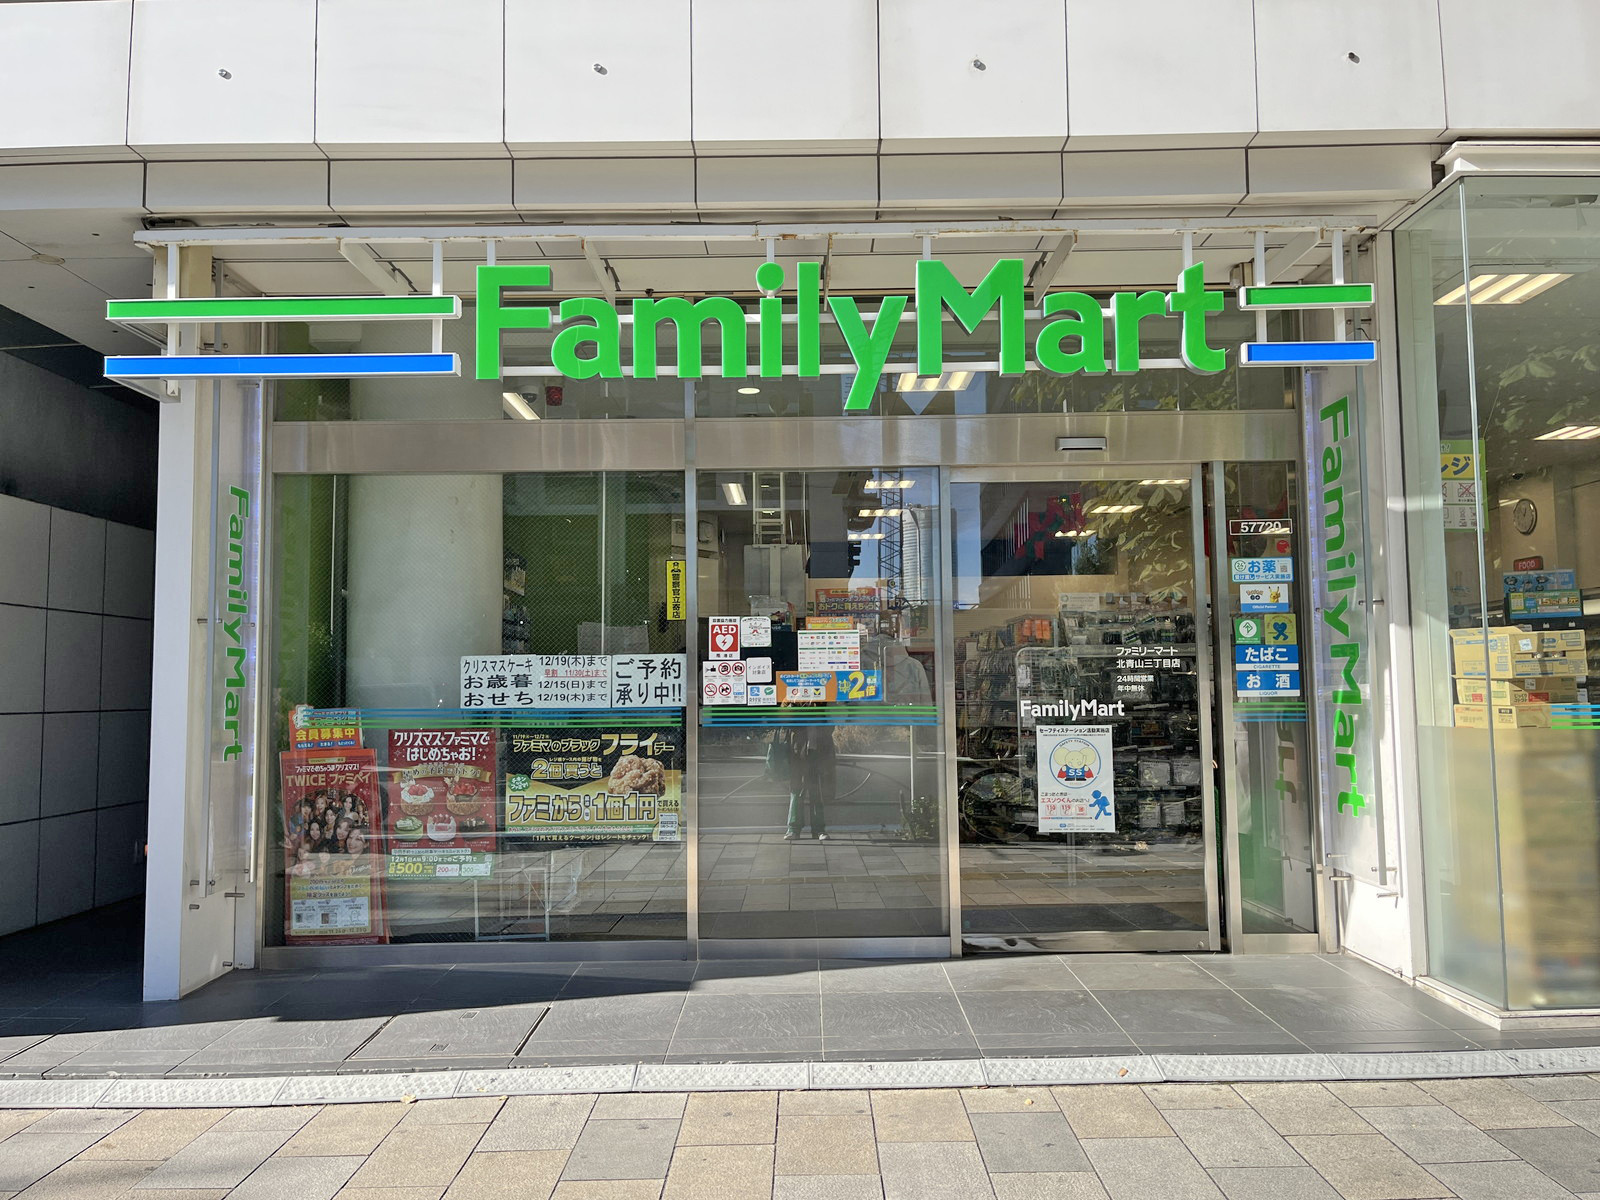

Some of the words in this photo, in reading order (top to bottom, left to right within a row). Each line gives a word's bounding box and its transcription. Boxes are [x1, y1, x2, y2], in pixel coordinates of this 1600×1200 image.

[476, 259, 1227, 410] FamilyMart
[1248, 560, 1276, 573] お薬
[671, 573, 681, 618] 警察官立寄店
[1318, 396, 1367, 818] FamilyMart
[223, 485, 250, 762] FamilyMart
[1116, 646, 1178, 656] ファミリーマート
[1245, 647, 1288, 661] たばこ
[463, 658, 533, 674] クリスマスケーキ
[539, 655, 607, 668] 12/19(木)まで
[616, 658, 681, 680] ご予約
[1116, 659, 1181, 668] 北青山三丁目店
[463, 674, 533, 689] お歳暮
[538, 680, 607, 690] 12/15(日)まで
[1246, 674, 1290, 688] お酒
[463, 691, 534, 707] おせち
[538, 693, 607, 702] 12/19(木)まで
[616, 682, 682, 705] 承り中!!
[1020, 699, 1125, 721] FamilyMart
[406, 747, 476, 761] はじめちゃお!
[531, 758, 603, 779] 2個買うと
[286, 774, 326, 787] TWICE
[329, 772, 371, 785] ファミペイ
